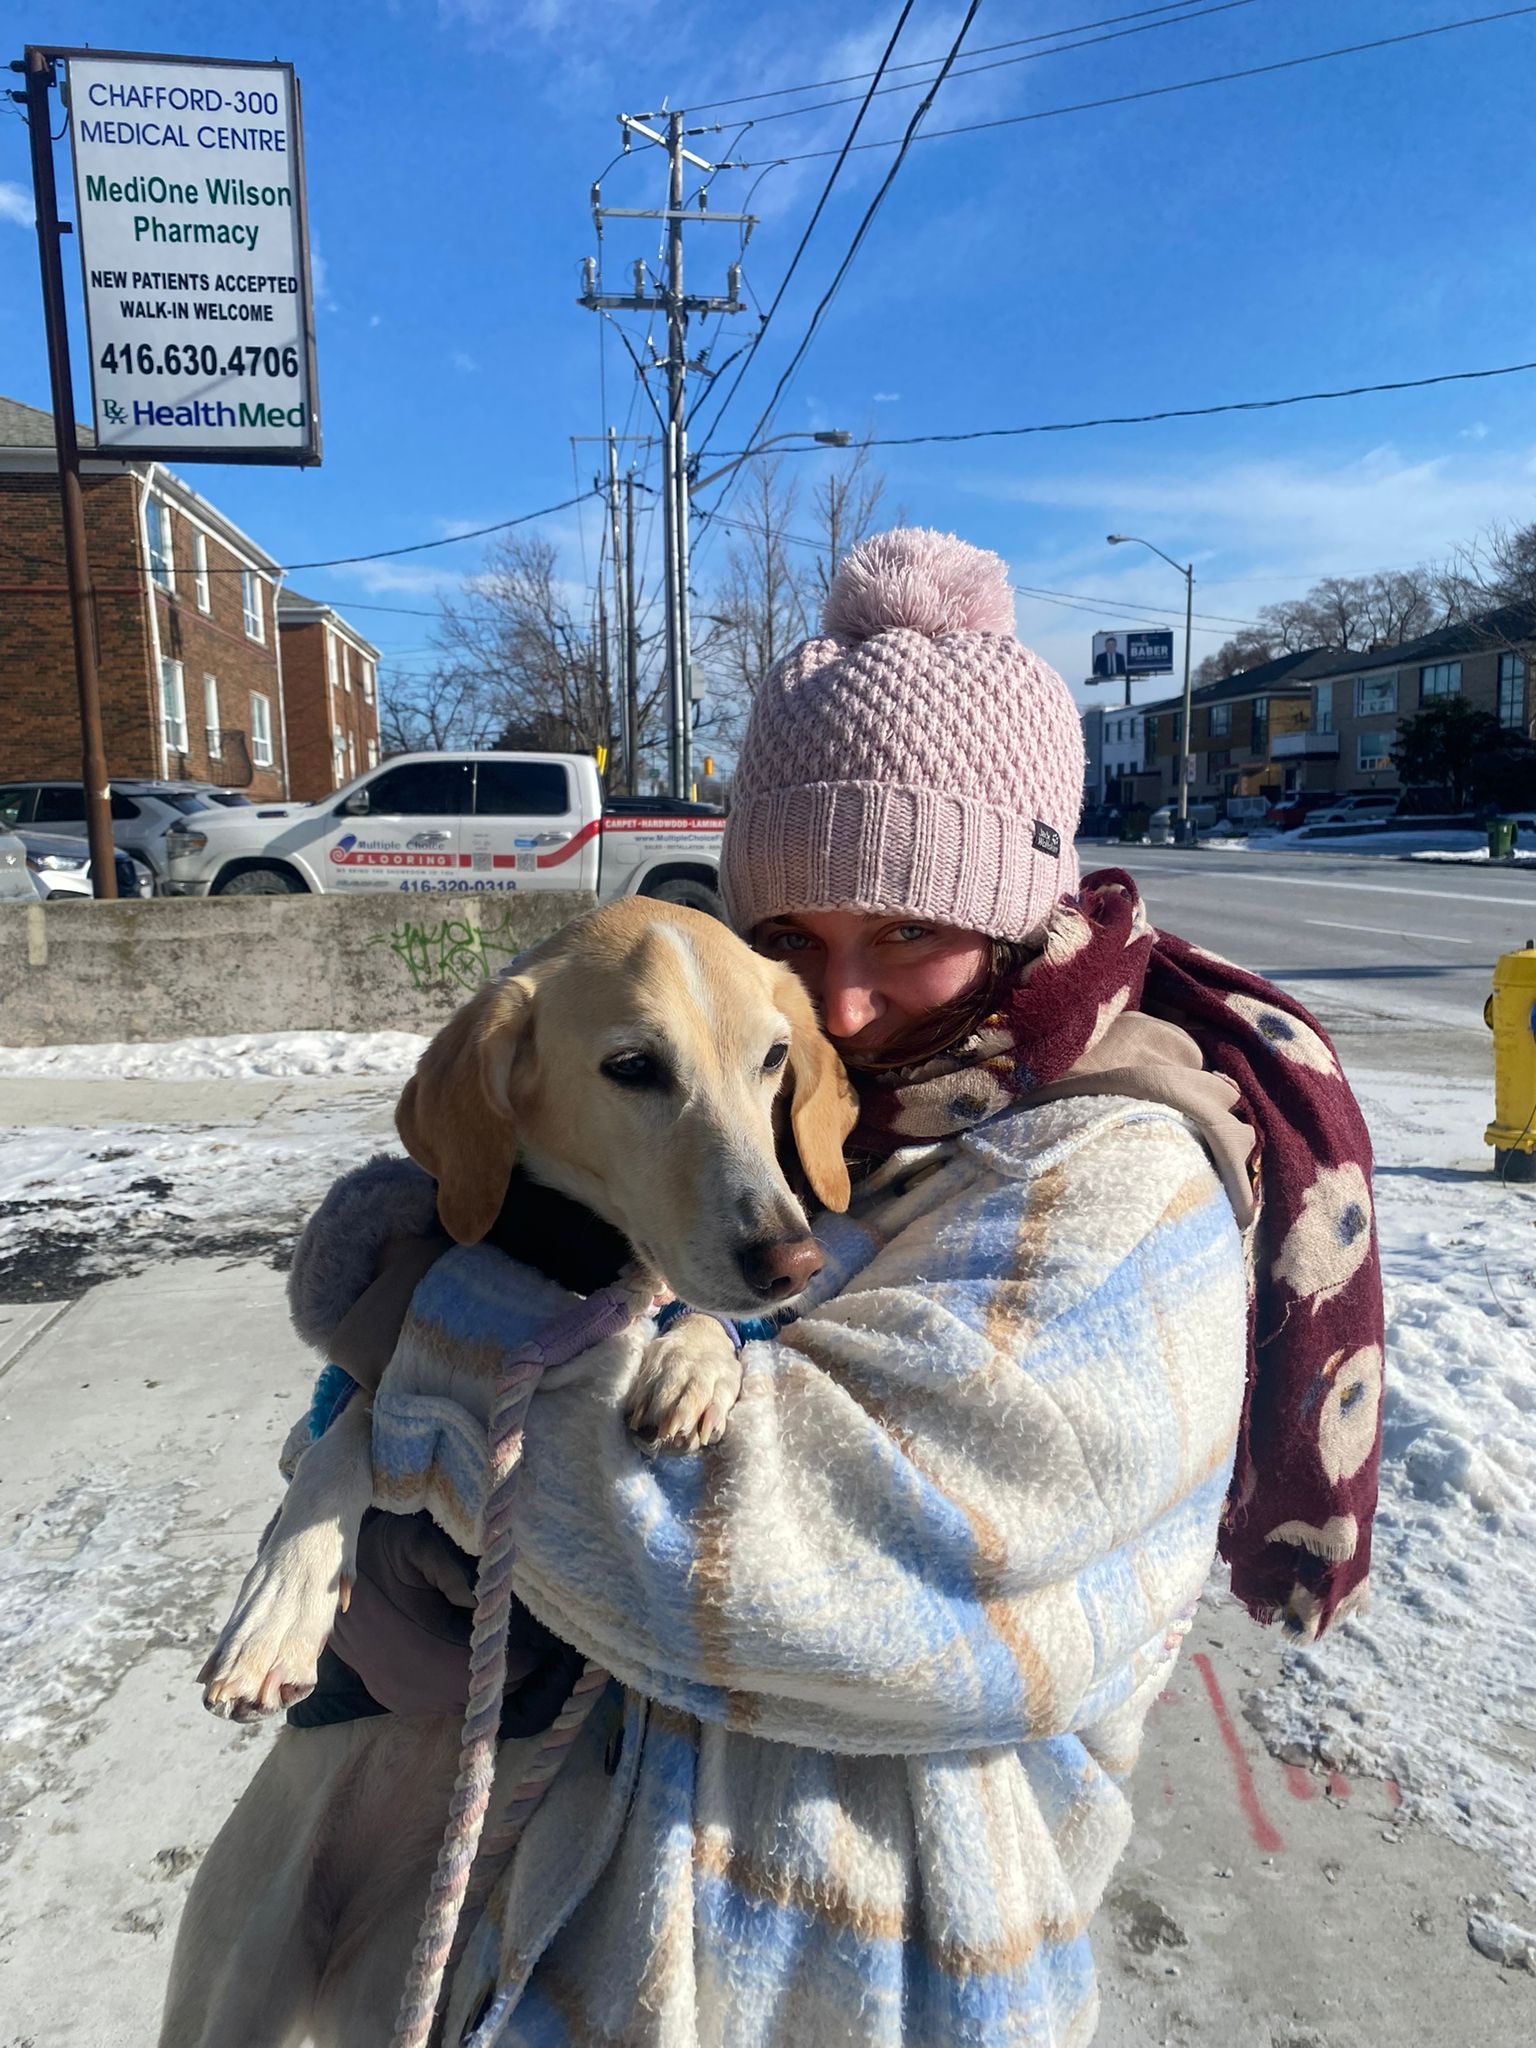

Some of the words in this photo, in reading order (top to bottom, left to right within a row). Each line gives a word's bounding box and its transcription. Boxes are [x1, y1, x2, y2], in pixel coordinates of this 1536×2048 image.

[89, 83, 278, 115] CHAFFORD-300
[80, 120, 189, 147] MEDICAL
[197, 126, 287, 152] CENTRE
[86, 175, 198, 204] MediOne
[206, 179, 292, 206] Wilson
[134, 216, 259, 251] Pharmacy
[91, 271, 127, 289] NEW
[132, 272, 209, 291] PATIENTS
[215, 275, 298, 294] ACCEPTED
[120, 301, 189, 319] WALK-IN
[193, 303, 273, 321] WELCOME
[101, 343, 299, 377] 416.630.4706
[133, 400, 305, 427] HealthMed
[1130, 646, 1169, 657] BABER
[605, 819, 637, 828] CARPET
[357, 840, 401, 851] Multiple
[406, 840, 445, 850] Choice
[356, 853, 447, 866] FLOORING
[400, 879, 517, 893] 416-320-0318
